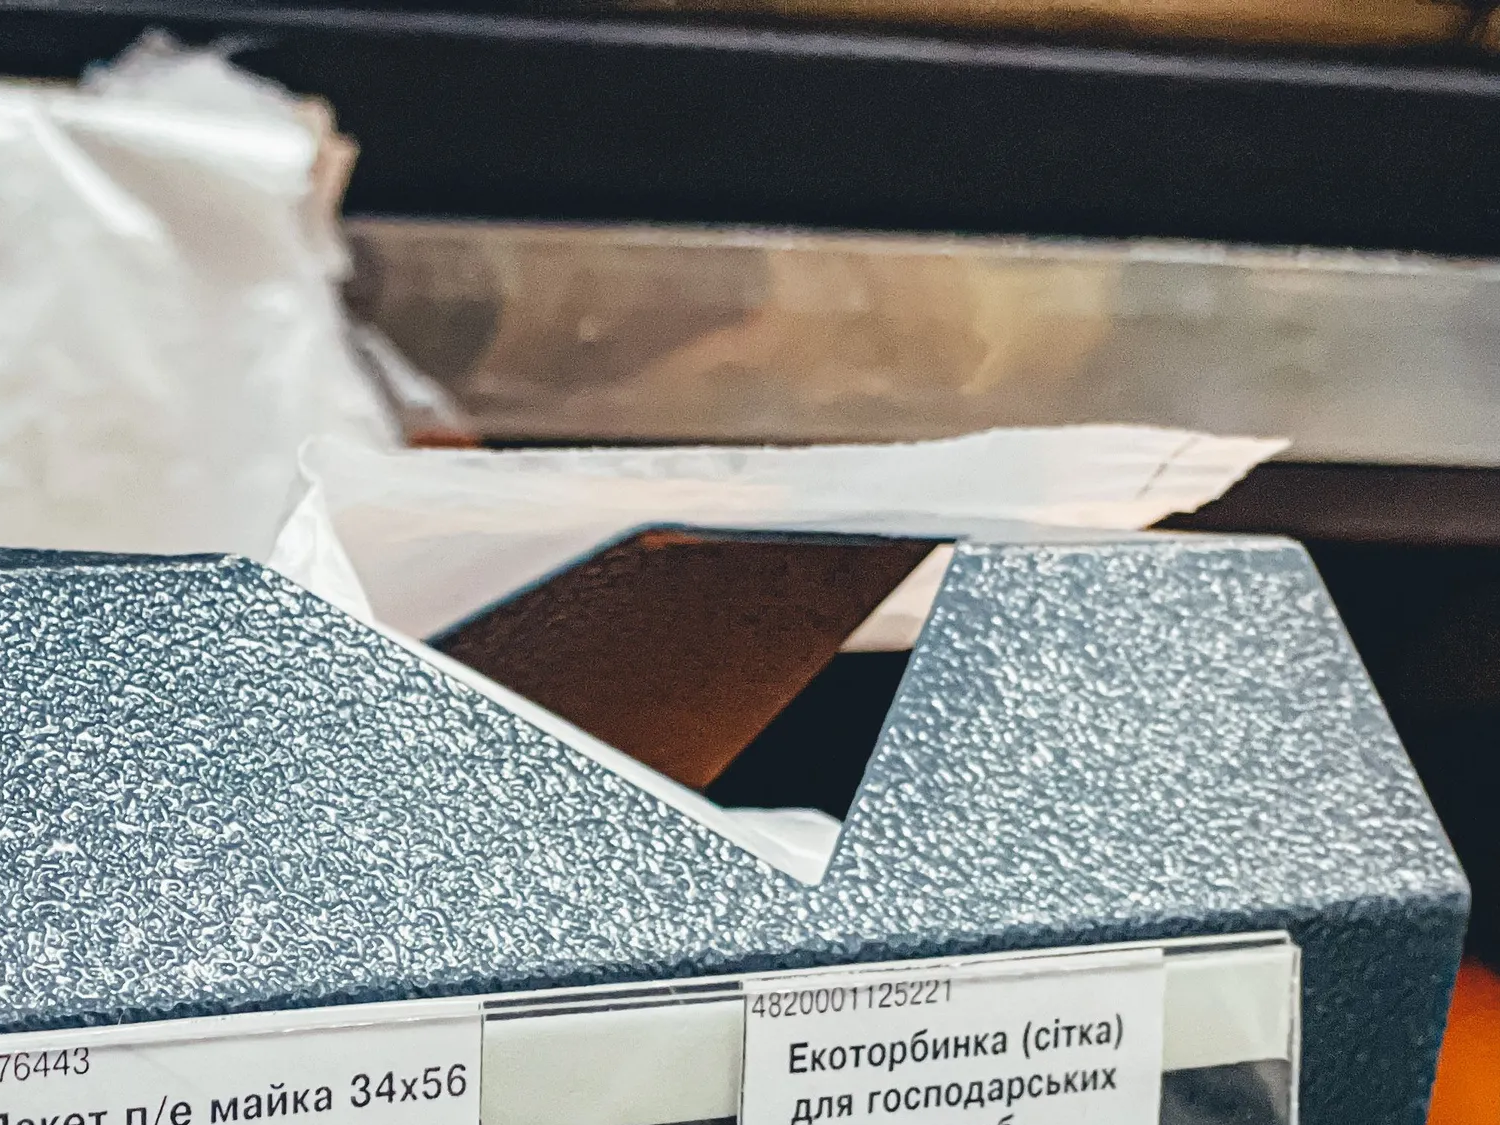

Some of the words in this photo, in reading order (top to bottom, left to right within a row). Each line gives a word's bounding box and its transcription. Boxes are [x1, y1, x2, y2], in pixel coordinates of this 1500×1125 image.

[752, 979, 952, 1018] 4820001125221
[788, 1028, 1008, 1074] Екоторбинка
[1023, 1014, 1124, 1059] (сітка)
[210, 1082, 333, 1124] майка
[867, 1066, 1117, 1114] господарських
